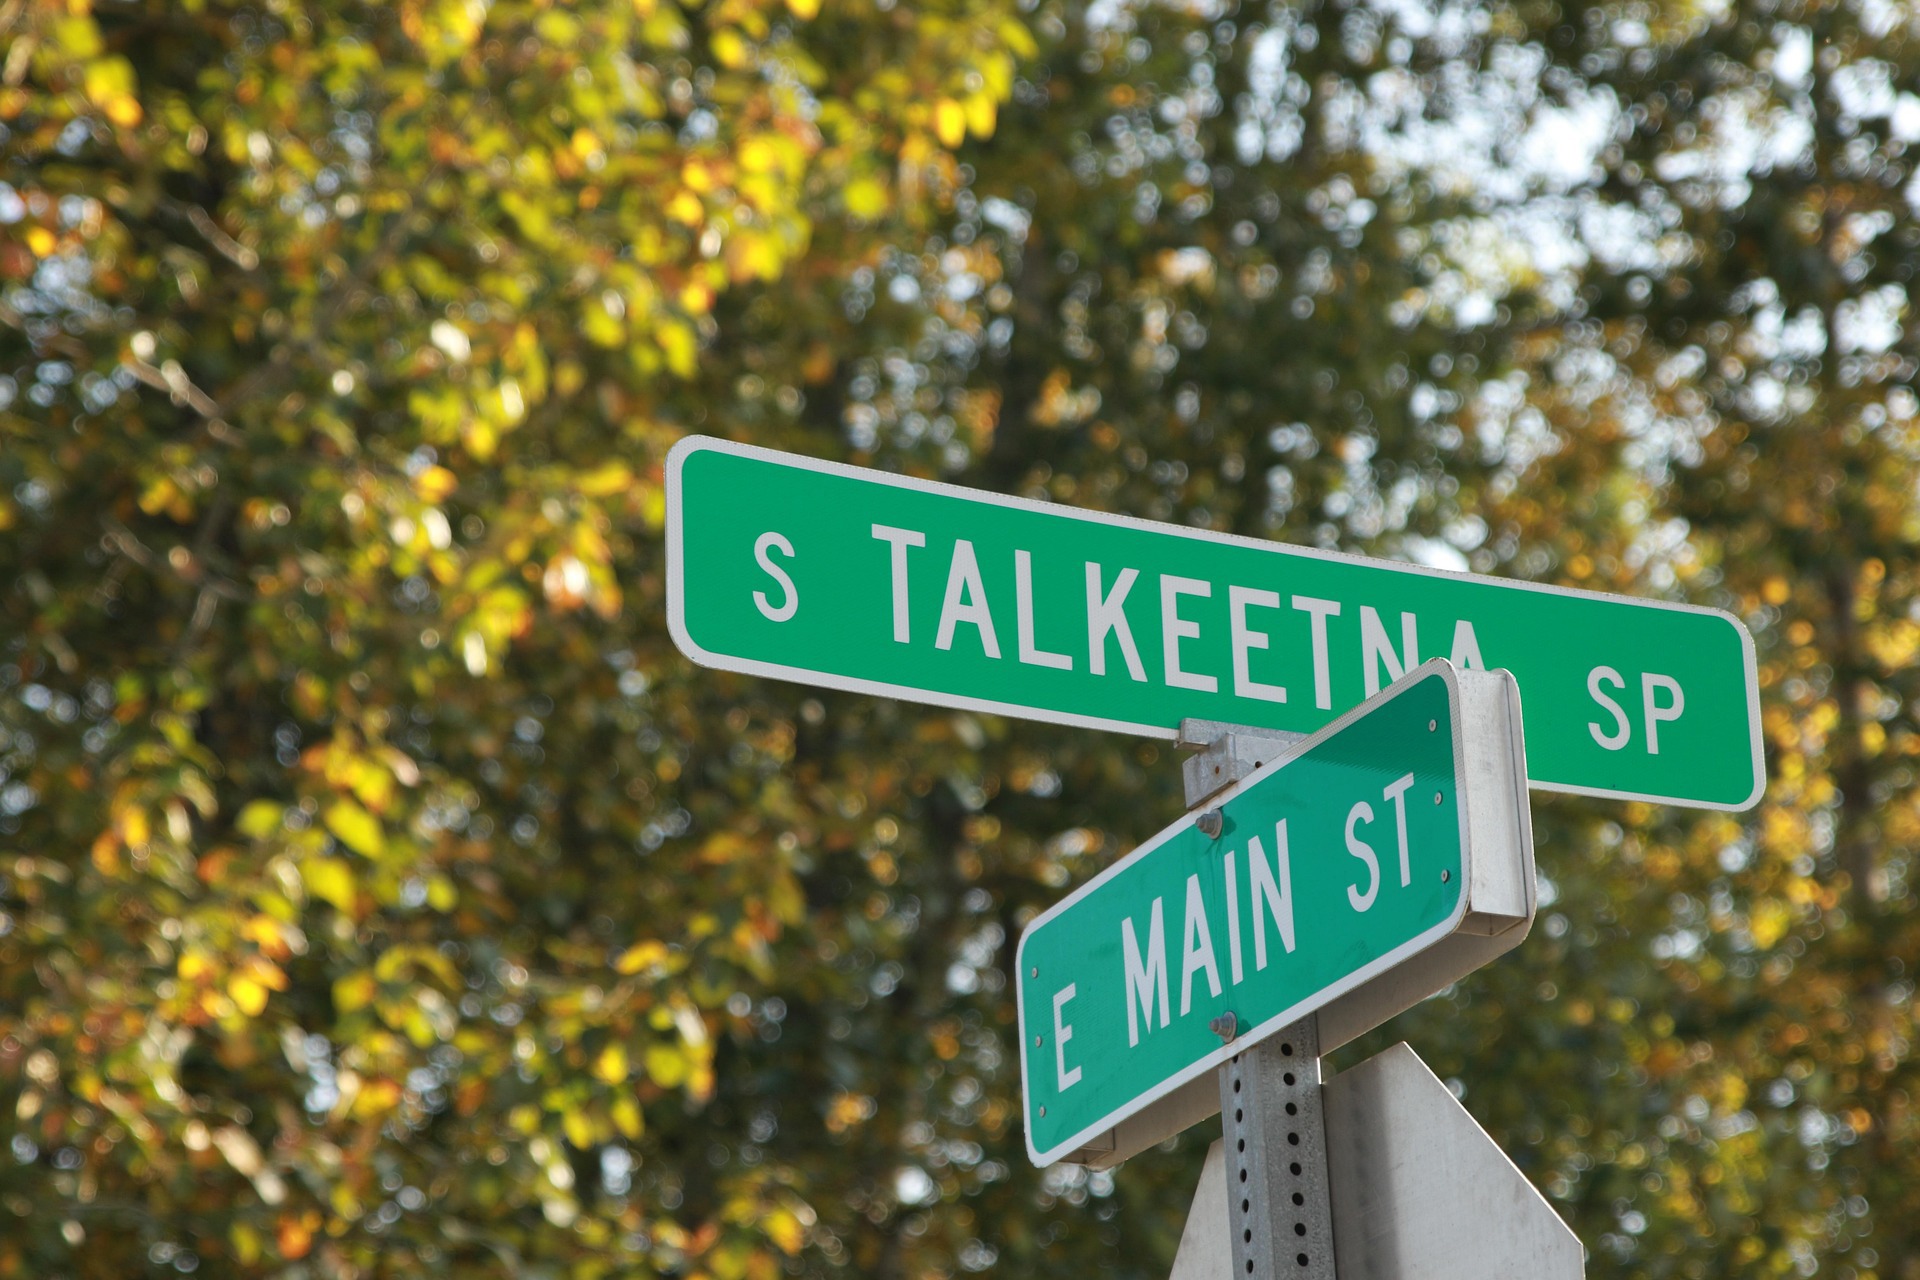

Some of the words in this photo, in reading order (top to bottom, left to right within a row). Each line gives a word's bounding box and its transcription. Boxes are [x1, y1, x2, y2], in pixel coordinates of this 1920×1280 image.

[752, 531, 799, 623] S
[1587, 665, 1685, 755] SP
[1052, 982, 1083, 1093] E
[1121, 817, 1296, 1048] MAIN
[1344, 772, 1415, 913] ST
